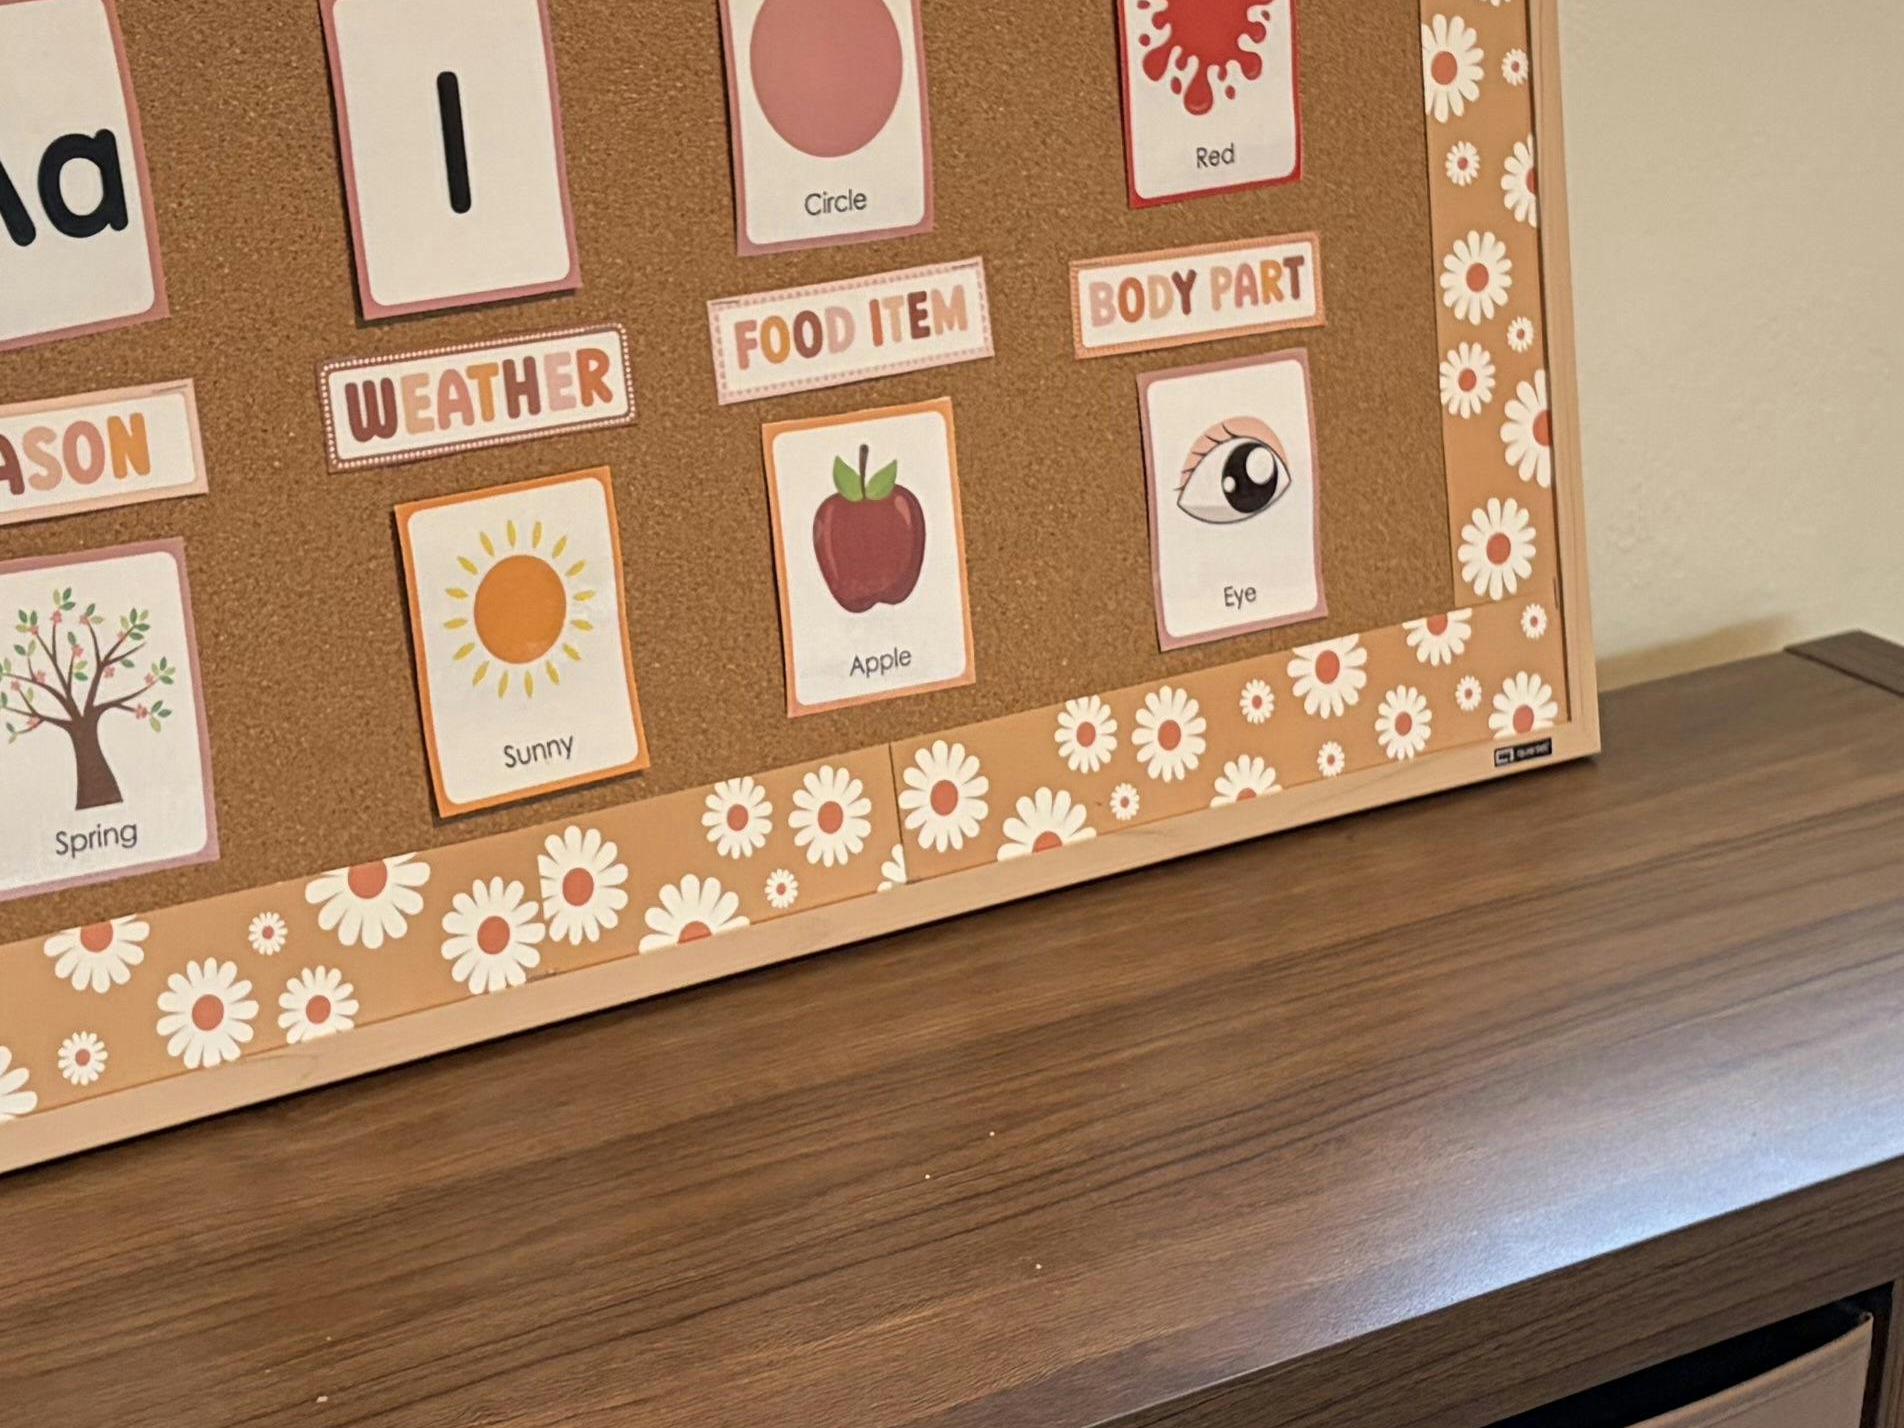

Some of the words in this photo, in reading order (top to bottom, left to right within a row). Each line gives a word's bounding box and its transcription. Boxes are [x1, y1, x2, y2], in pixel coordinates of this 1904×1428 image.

[1194, 143, 1236, 170] Red
[803, 187, 868, 217] Circle
[1088, 267, 1197, 328] BODY
[1210, 255, 1306, 311] PART
[733, 305, 856, 371] FOOD
[869, 284, 968, 348] ITEM
[343, 347, 614, 443] WEATHER
[1222, 581, 1257, 612] Eye
[848, 644, 912, 678] Apple
[502, 733, 575, 772] Sunny
[54, 819, 138, 859] Spring
